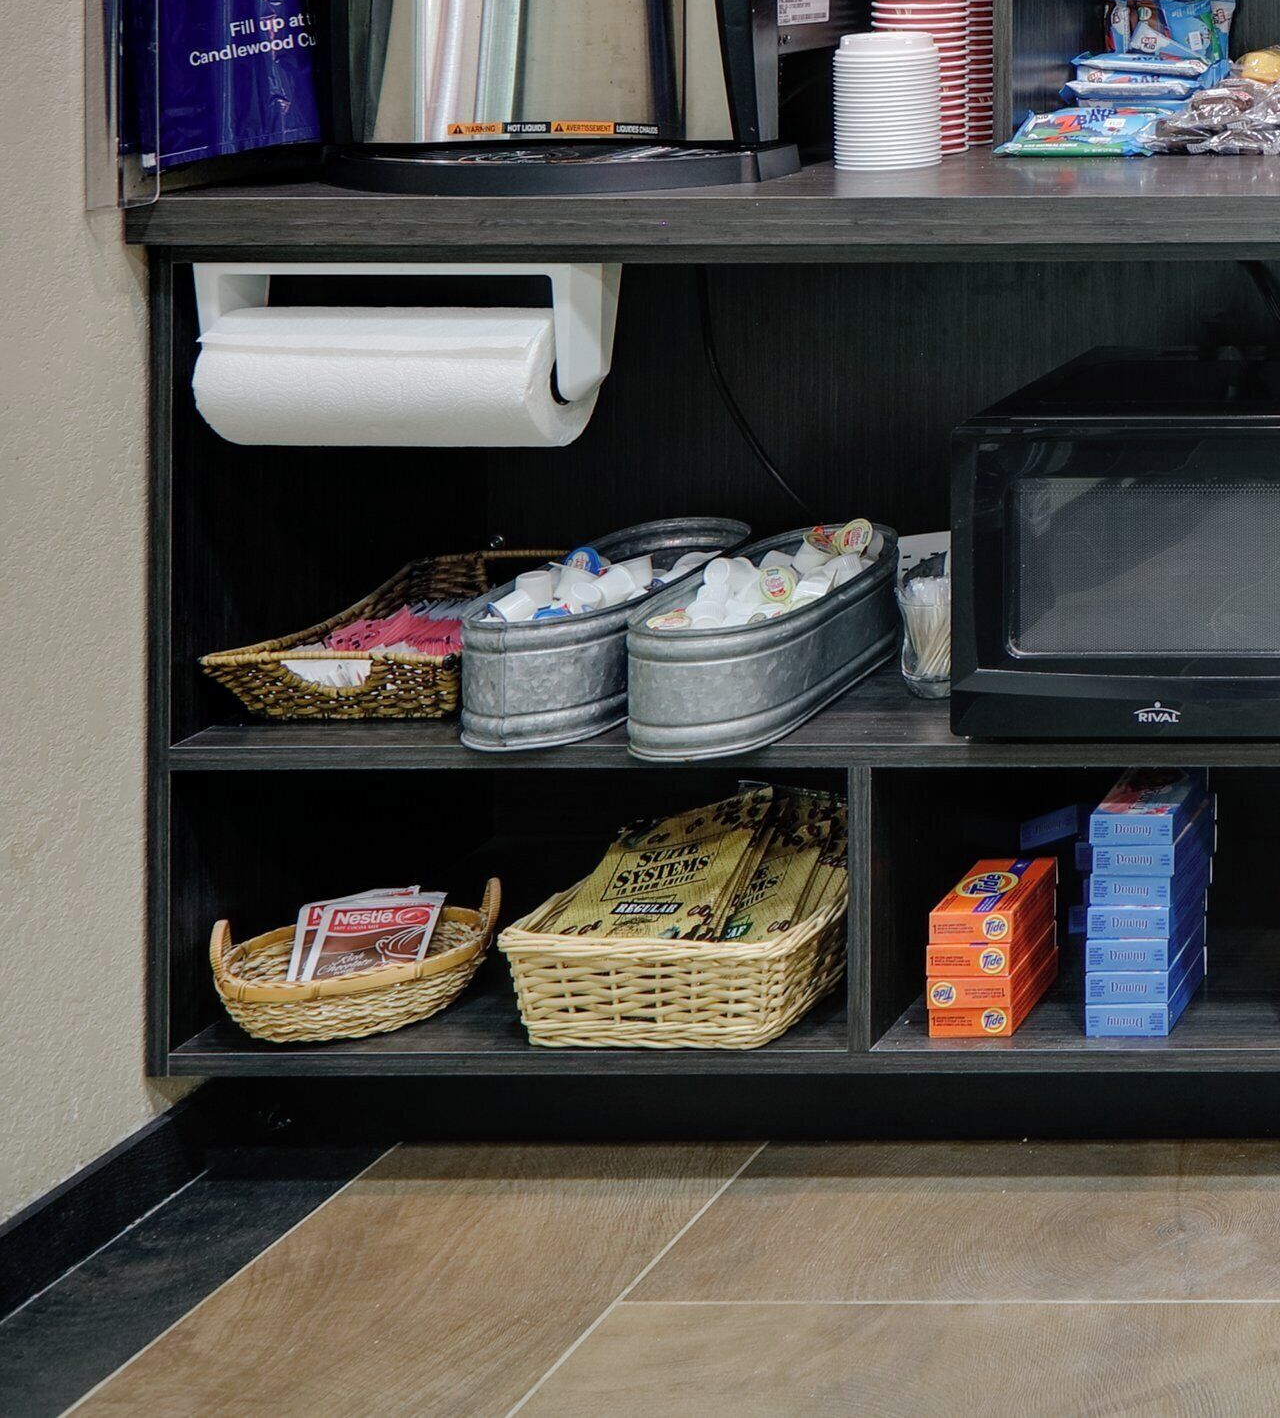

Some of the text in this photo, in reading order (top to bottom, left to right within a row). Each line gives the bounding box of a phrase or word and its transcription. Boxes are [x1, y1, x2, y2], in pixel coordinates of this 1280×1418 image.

[229, 12, 304, 37] Fill up at
[189, 36, 294, 67] Candlewood
[522, 124, 546, 132] LIQUIDS
[566, 124, 611, 132] AVERTISSEMENT
[1139, 710, 1180, 724] RIVAL
[1113, 823, 1153, 838] Downy
[637, 842, 702, 868] SUITE
[1115, 853, 1153, 868] Downy
[612, 855, 711, 889] SYSTEMS
[615, 903, 677, 914] REGULAR
[984, 918, 1006, 936] Tide
[336, 952, 365, 965] Rich
[981, 952, 1004, 970] Tide
